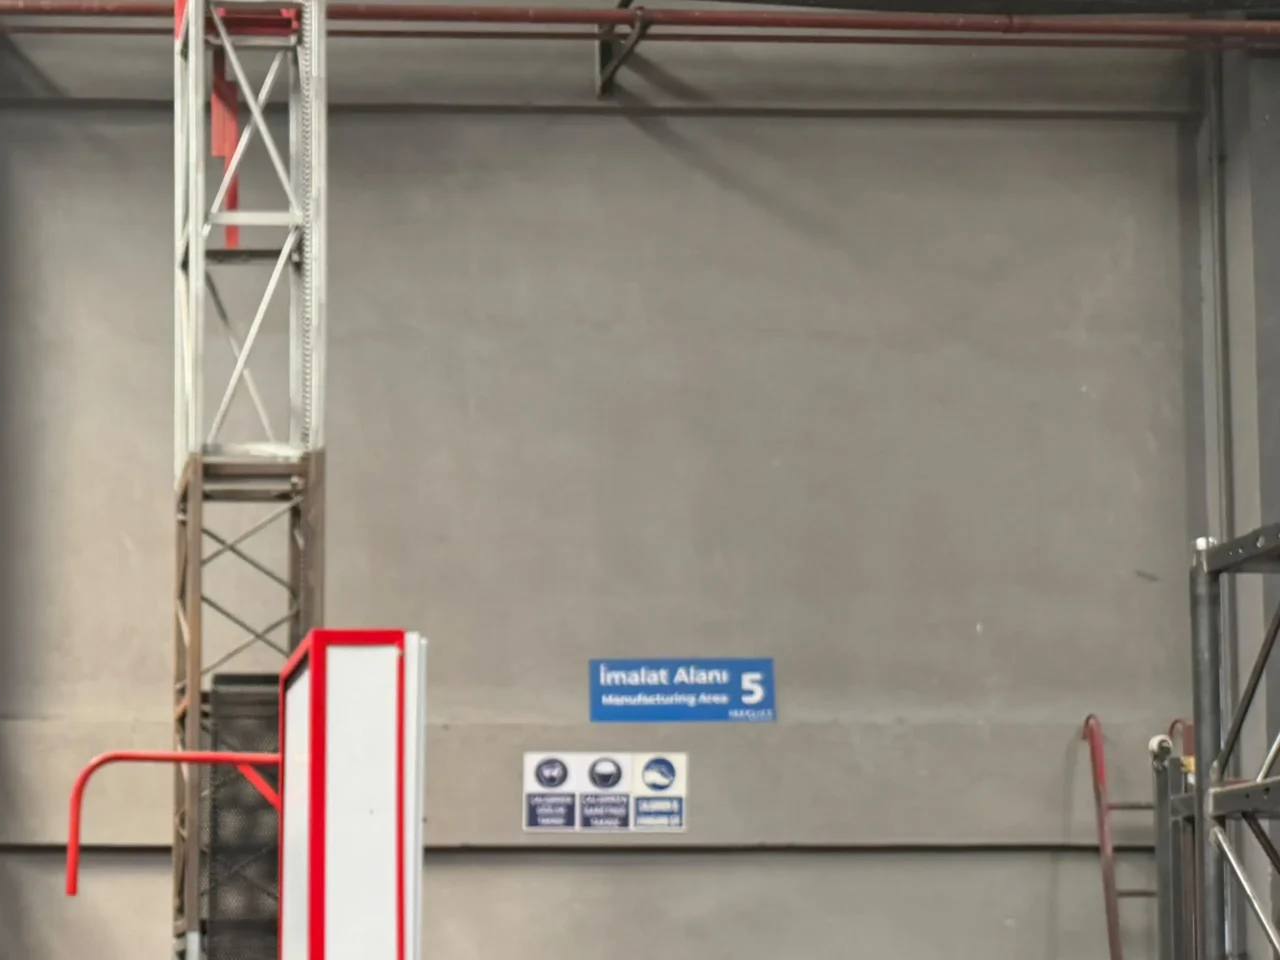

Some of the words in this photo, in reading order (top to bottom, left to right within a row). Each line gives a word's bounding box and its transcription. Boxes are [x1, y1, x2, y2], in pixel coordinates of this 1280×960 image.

[600, 663, 669, 686] İmalat
[673, 665, 729, 685] Alanı
[602, 692, 696, 707] Manufacturing
[698, 692, 729, 705] Area
[741, 671, 765, 705] 5
